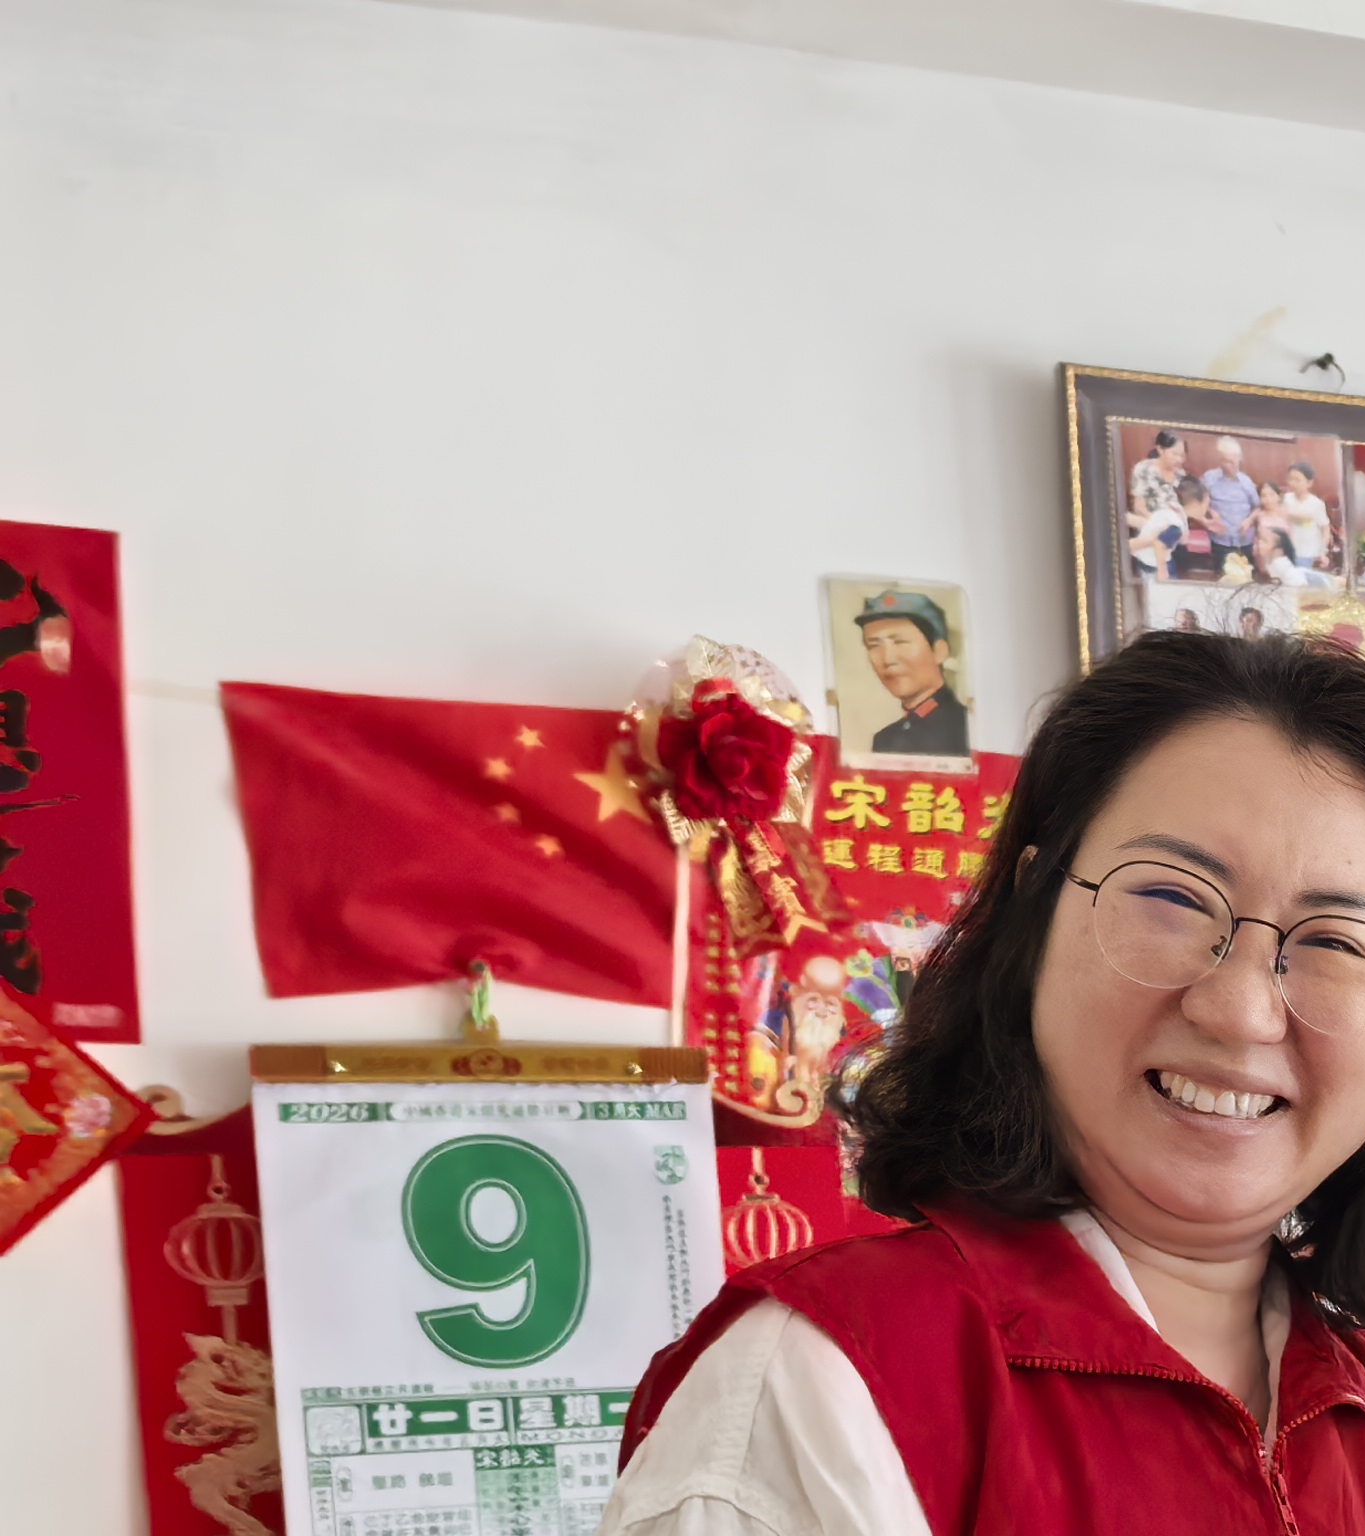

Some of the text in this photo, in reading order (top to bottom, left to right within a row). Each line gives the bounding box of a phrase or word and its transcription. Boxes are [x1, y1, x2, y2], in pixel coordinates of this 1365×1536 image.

[290, 1103, 369, 1122] 2026
[401, 1134, 590, 1369] 9
[372, 1398, 505, 1437] 廿一日
